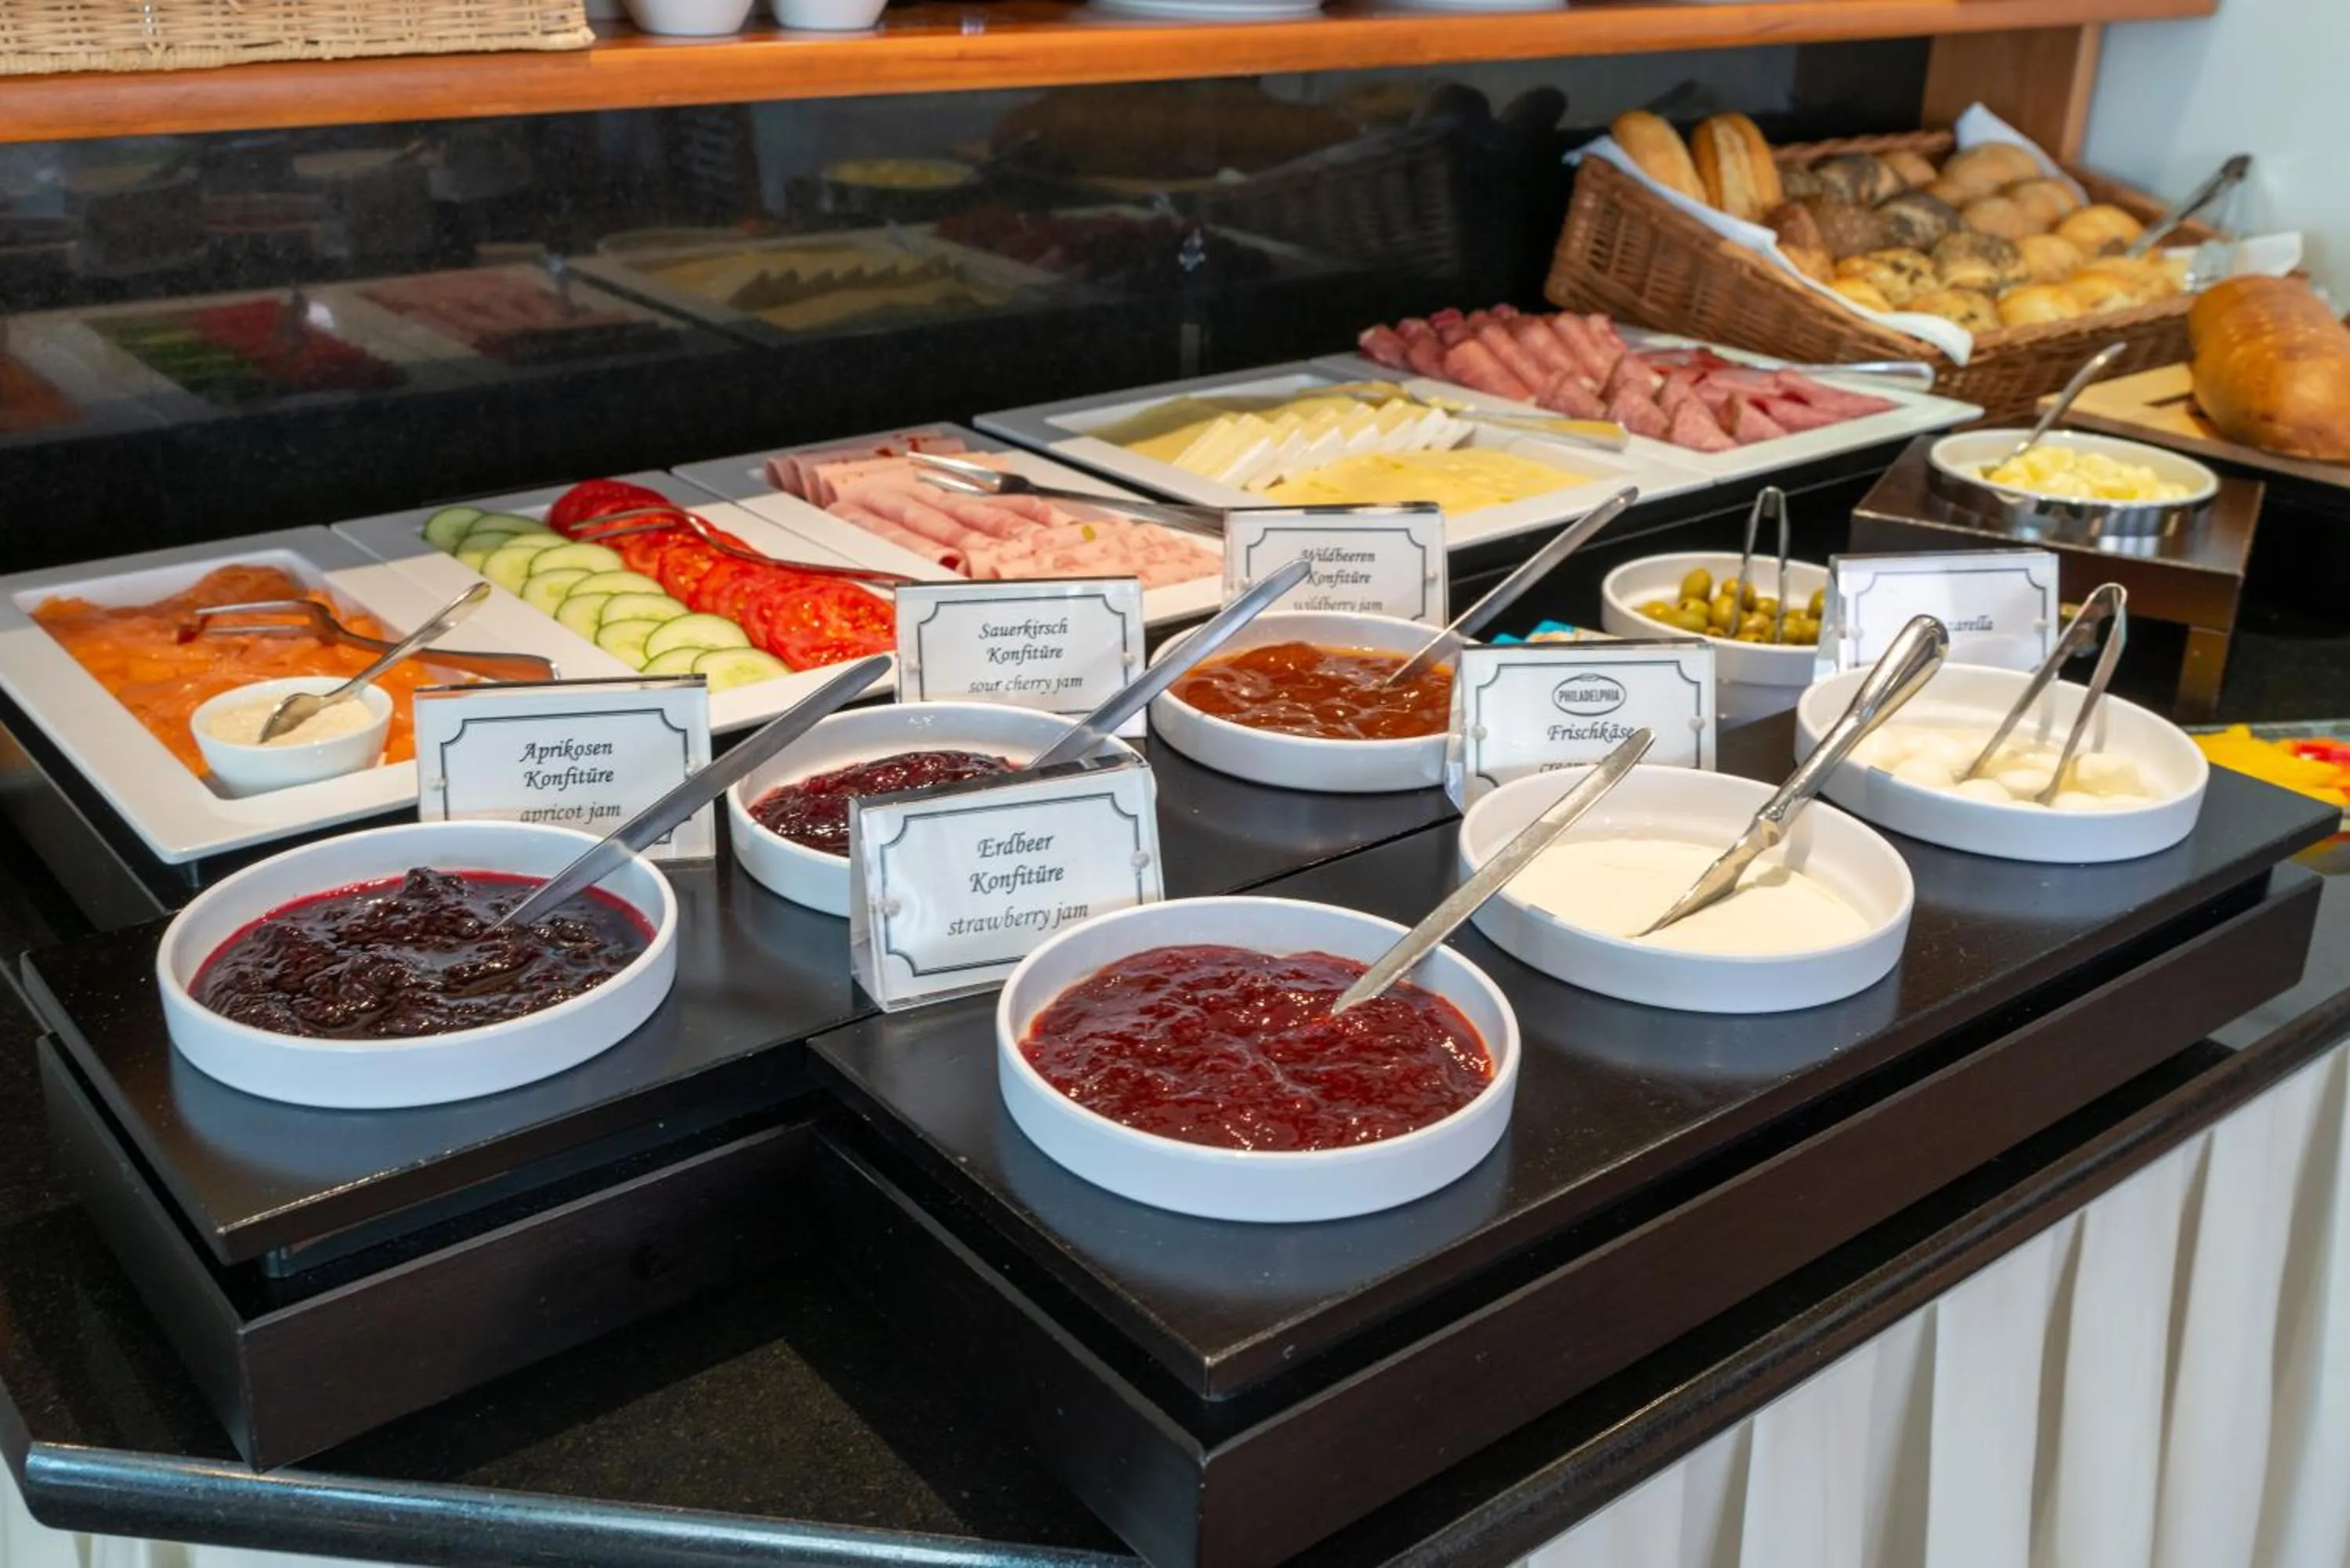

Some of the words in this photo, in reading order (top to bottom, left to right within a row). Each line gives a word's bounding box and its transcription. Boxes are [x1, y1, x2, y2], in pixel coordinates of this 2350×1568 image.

[1306, 569, 1372, 589] Konfitüre
[1358, 596, 1383, 613] jam
[978, 617, 1068, 640] Sauerkirsch
[986, 643, 1064, 666] Konfitüre
[967, 680, 1003, 694] sour
[1005, 674, 1053, 695] cherry
[1052, 675, 1084, 695] jam
[1558, 688, 1620, 703] PHILADELPHIA
[1547, 721, 1635, 744] Frischkäse
[519, 739, 613, 765] Aprikosen
[523, 767, 614, 791] Konfitüre
[519, 803, 584, 823] apricot
[584, 801, 621, 825] jam
[977, 832, 1054, 860] Erdbeer
[969, 865, 1065, 896] Konfitüre
[947, 905, 1051, 937] strawberry
[1051, 901, 1089, 930] jam
